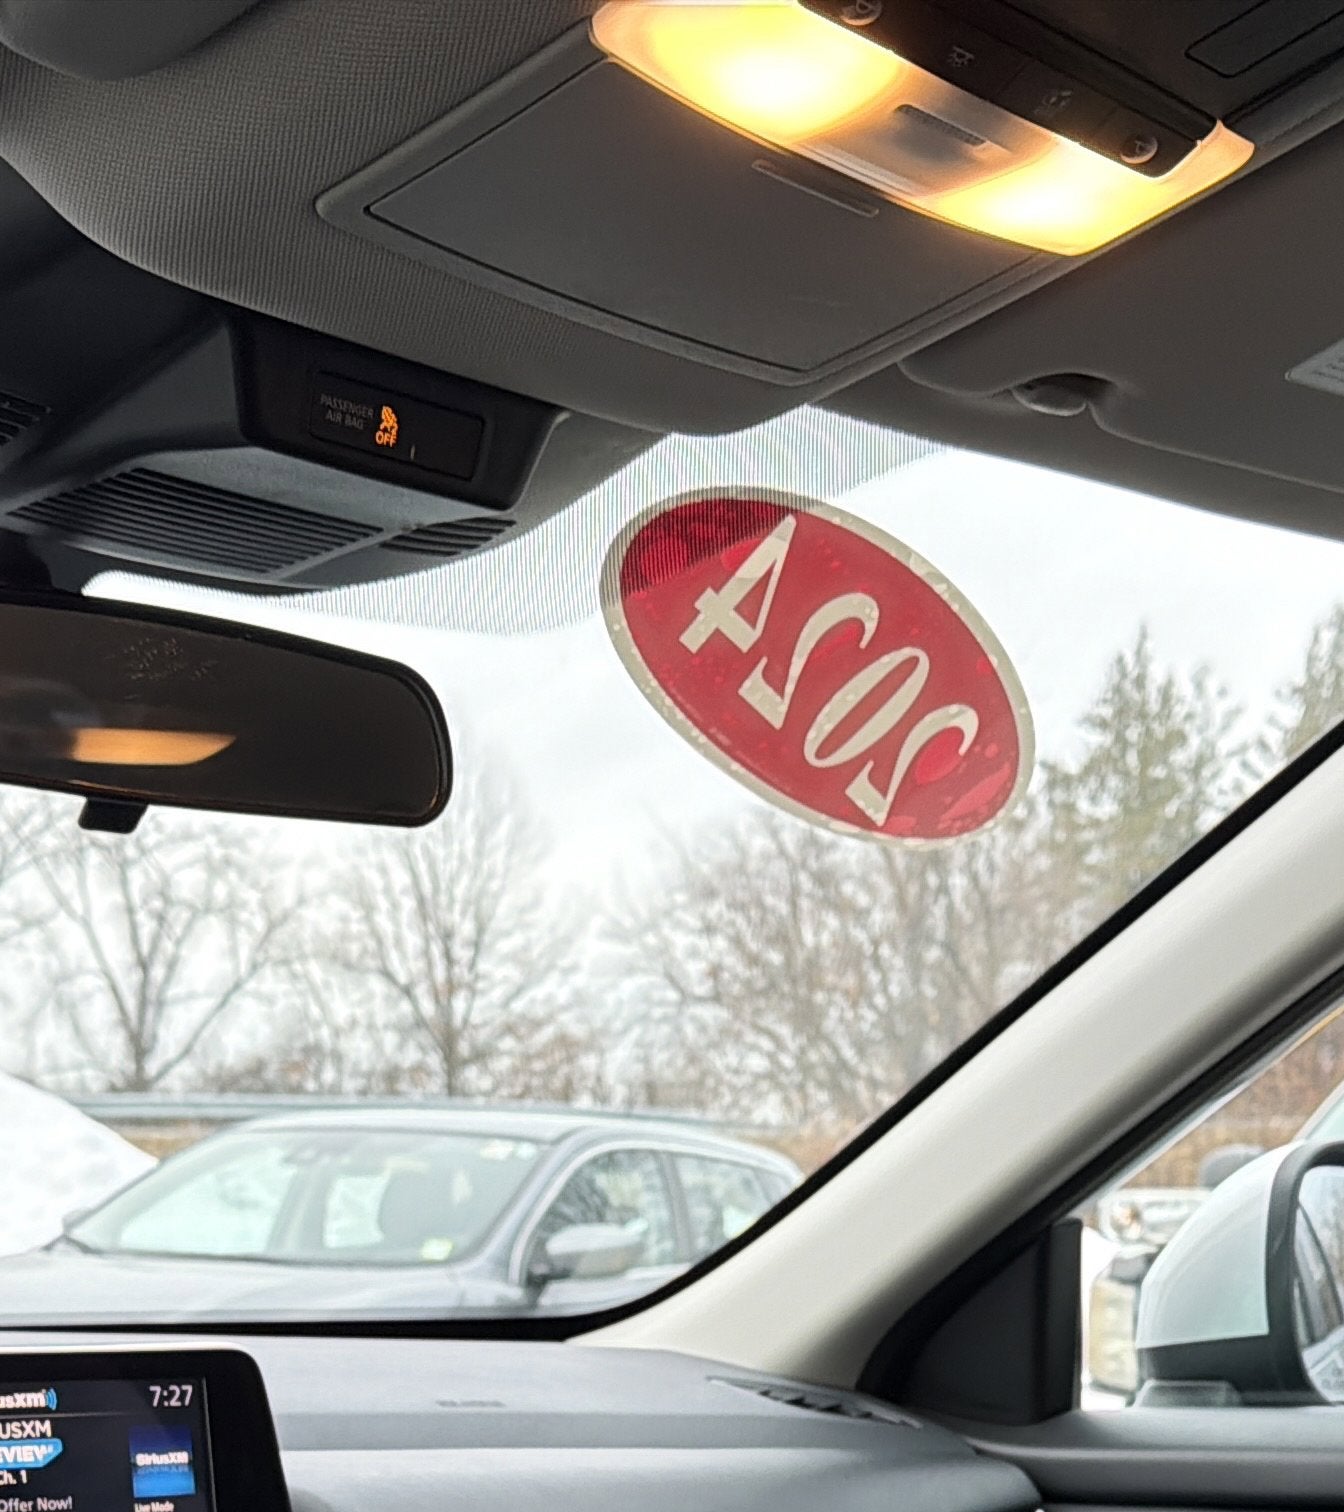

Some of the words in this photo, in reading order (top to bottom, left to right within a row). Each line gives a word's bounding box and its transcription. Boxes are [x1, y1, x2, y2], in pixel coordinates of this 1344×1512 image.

[320, 393, 374, 418] PASSENGER
[325, 409, 342, 424] AIR
[344, 414, 365, 431] BAG
[375, 430, 397, 448] OFF
[149, 1385, 193, 1408] 7:27
[20, 1470, 27, 1484] 1
[37, 1496, 73, 1512] Now!
